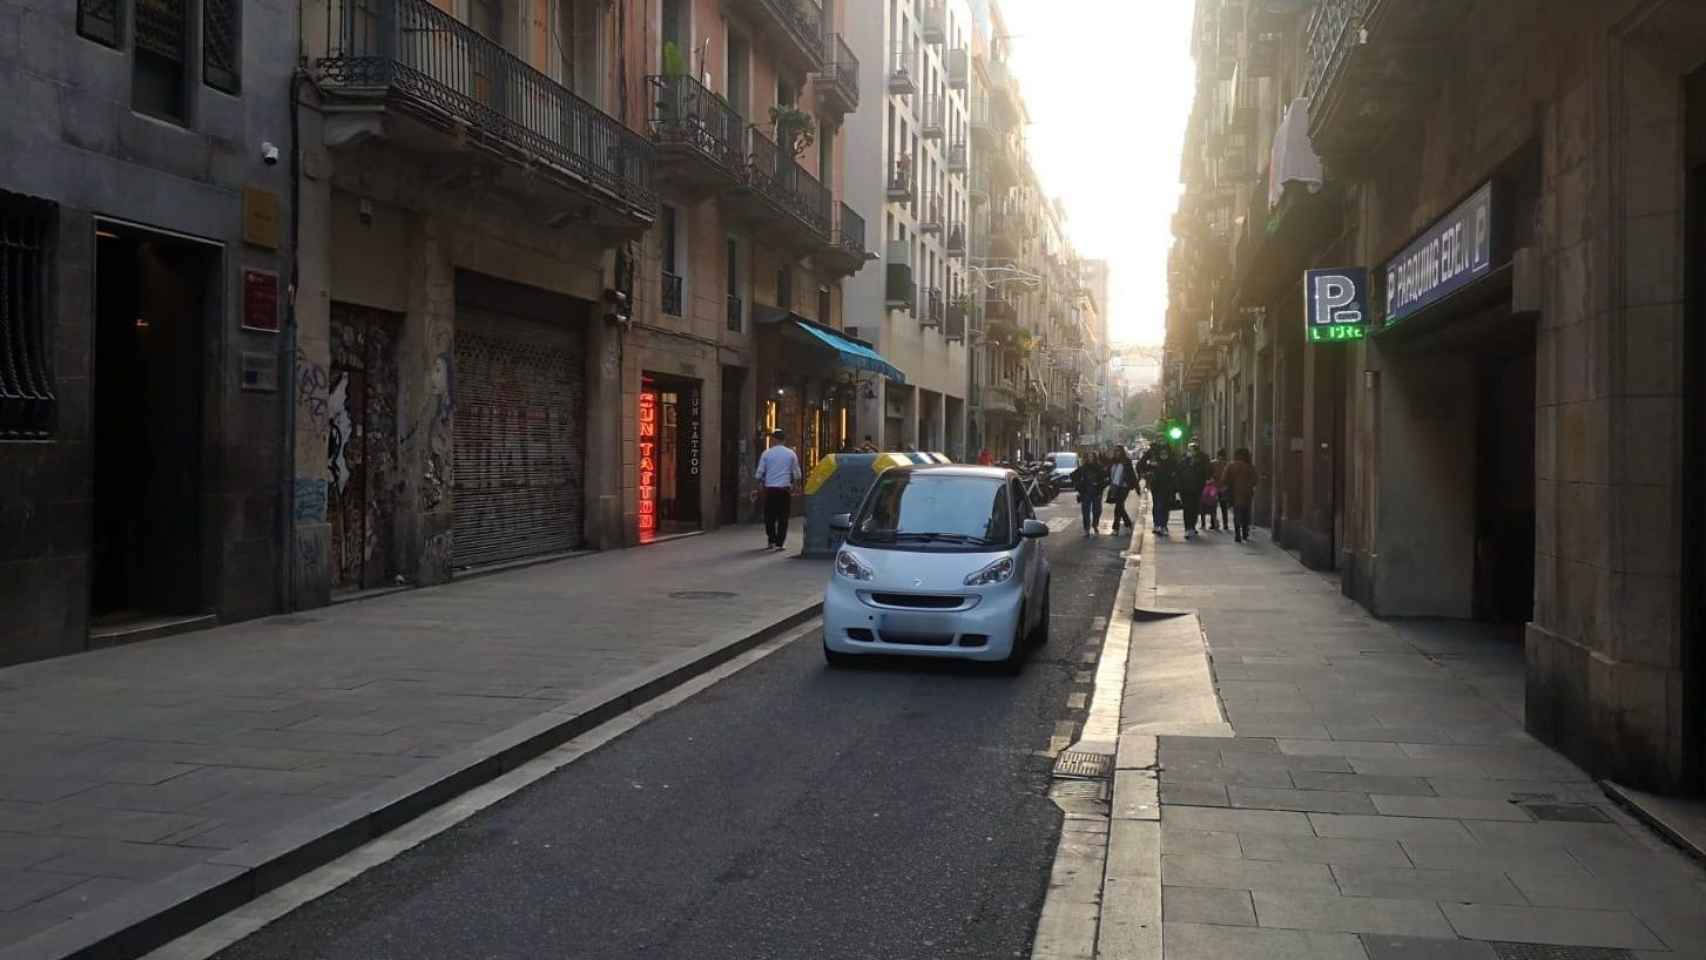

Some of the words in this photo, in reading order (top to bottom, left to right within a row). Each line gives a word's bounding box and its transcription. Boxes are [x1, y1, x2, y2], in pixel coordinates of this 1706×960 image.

[1315, 275, 1355, 324] P
[690, 421, 699, 475] TATTOO
[639, 443, 654, 528] TATTOO
